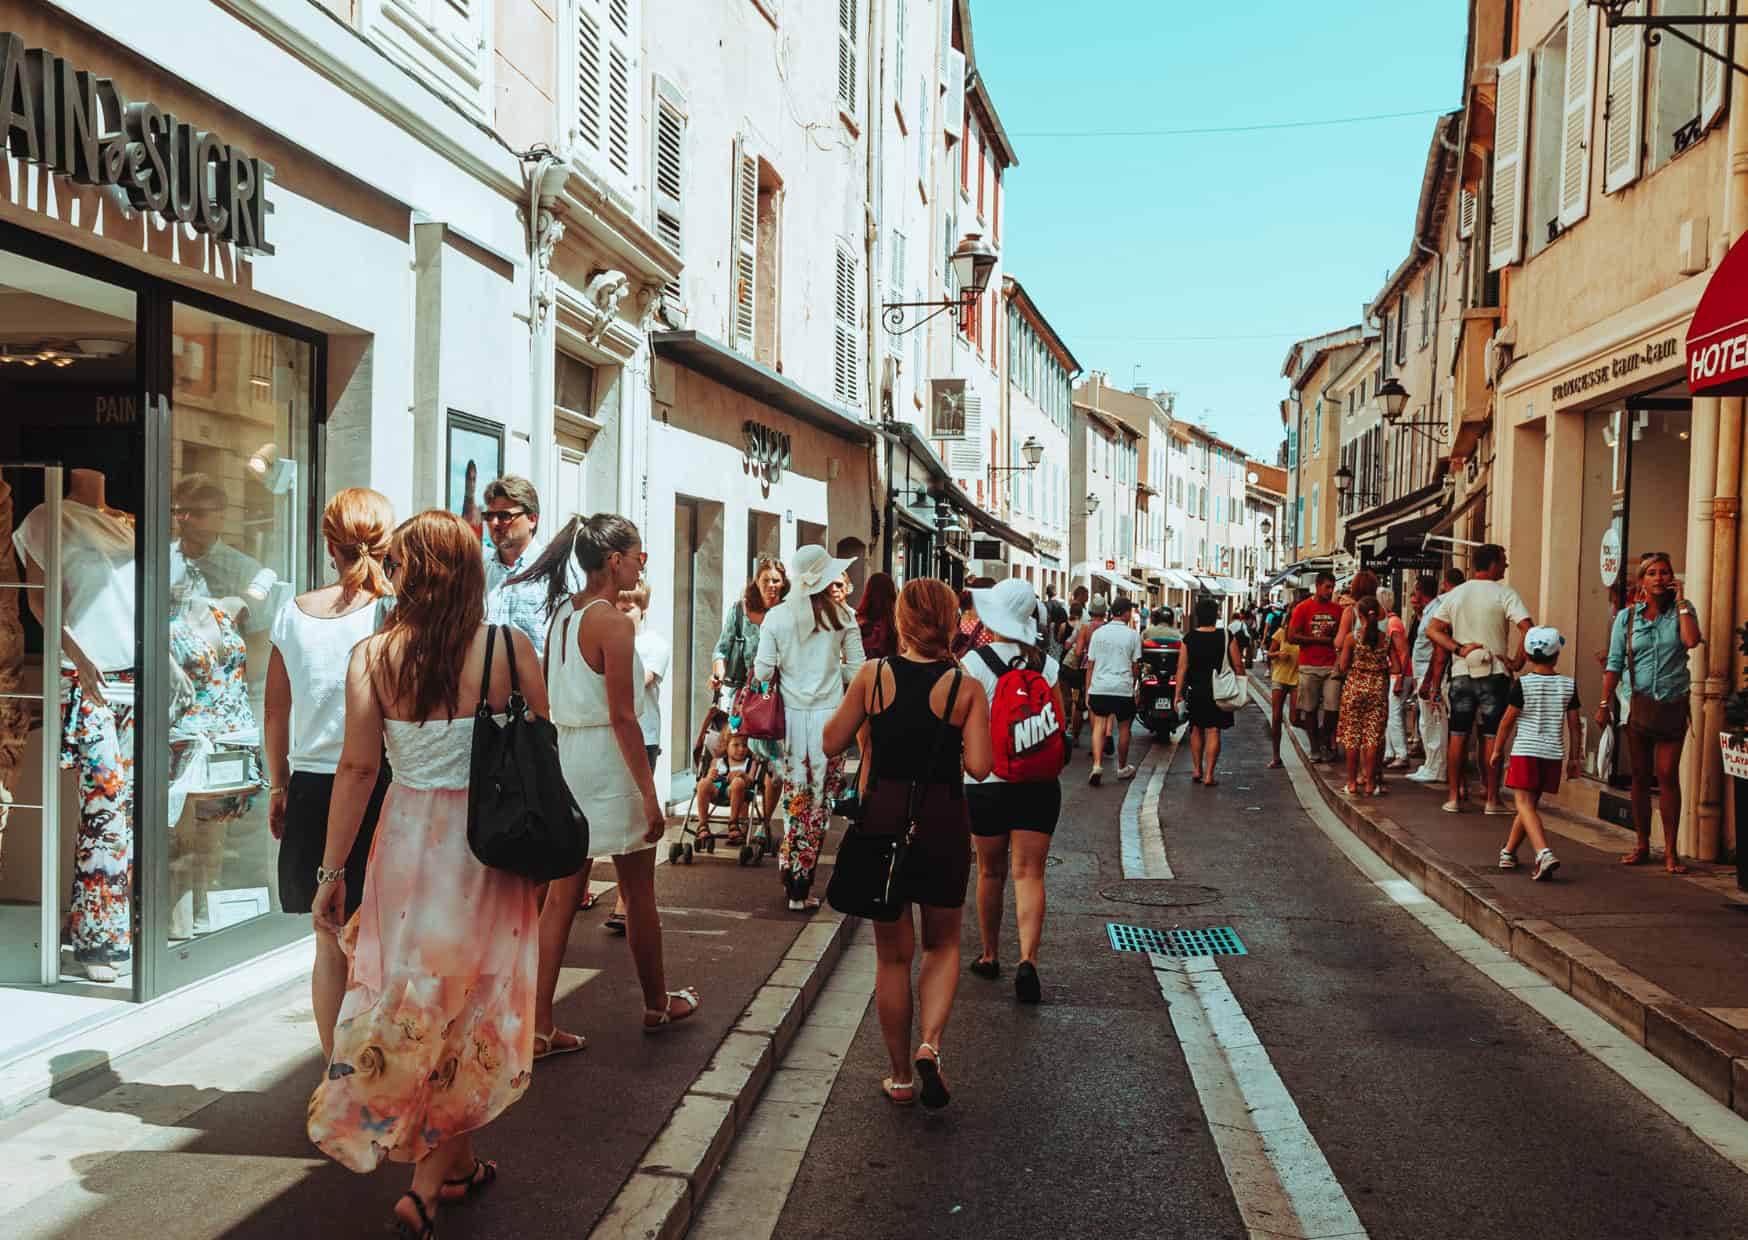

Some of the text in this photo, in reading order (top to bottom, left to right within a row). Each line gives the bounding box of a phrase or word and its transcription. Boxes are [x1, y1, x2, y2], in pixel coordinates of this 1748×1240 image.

[130, 101, 275, 257] SUCRE
[1690, 333, 1748, 383] HOTE
[96, 396, 137, 424] PAIN
[1014, 701, 1060, 753] NIKE
